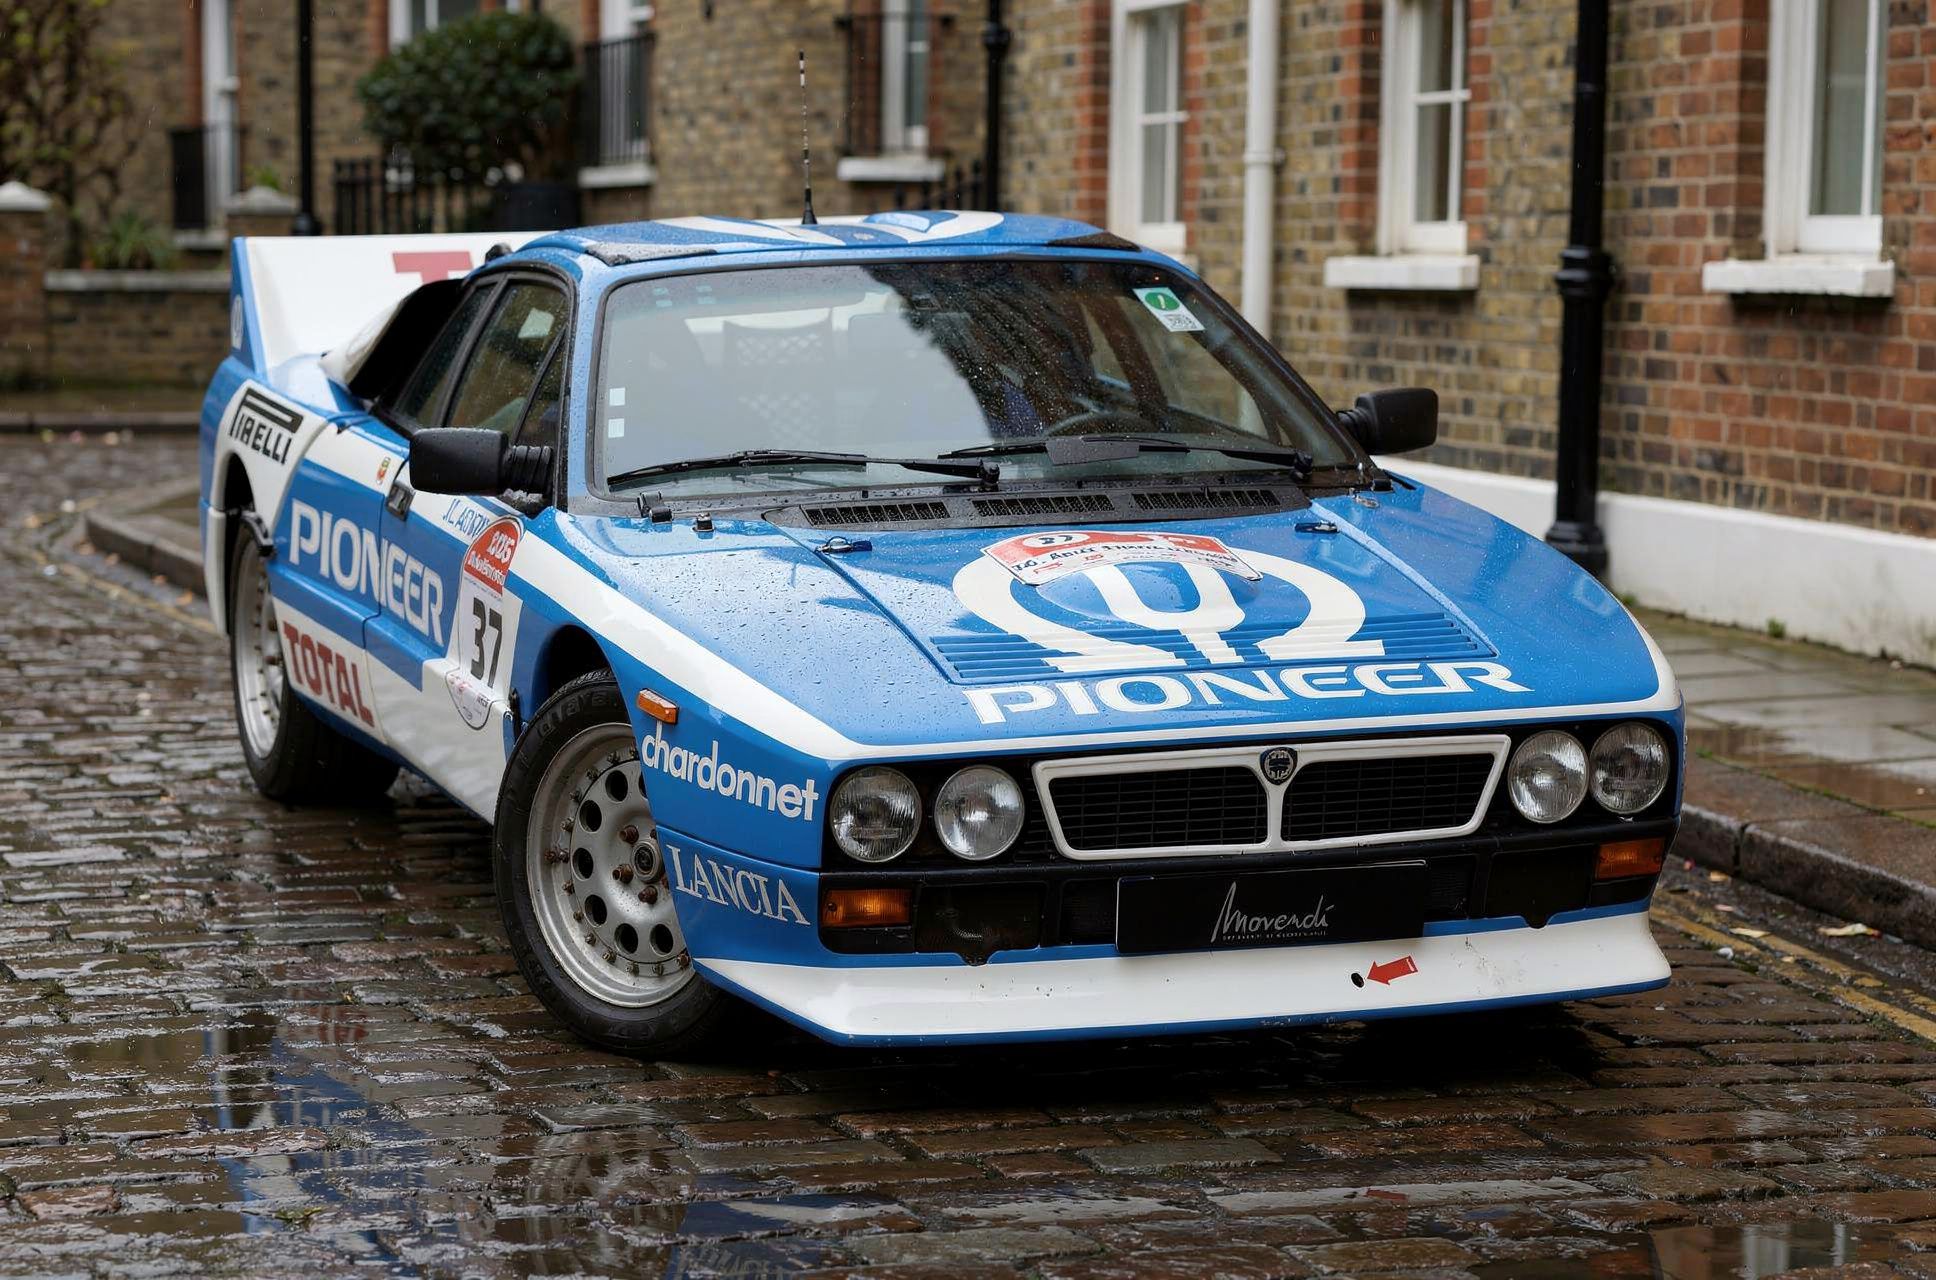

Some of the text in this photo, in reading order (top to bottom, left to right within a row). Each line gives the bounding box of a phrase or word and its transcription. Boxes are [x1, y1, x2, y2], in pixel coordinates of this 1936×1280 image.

[229, 387, 304, 465] PIRELLI
[288, 498, 444, 647] PIONEER
[283, 622, 375, 728] TOTAL
[470, 597, 503, 690] 37
[962, 661, 1535, 724] PIONEER
[641, 720, 820, 821] chardonnet
[666, 844, 811, 926] LANCIA
